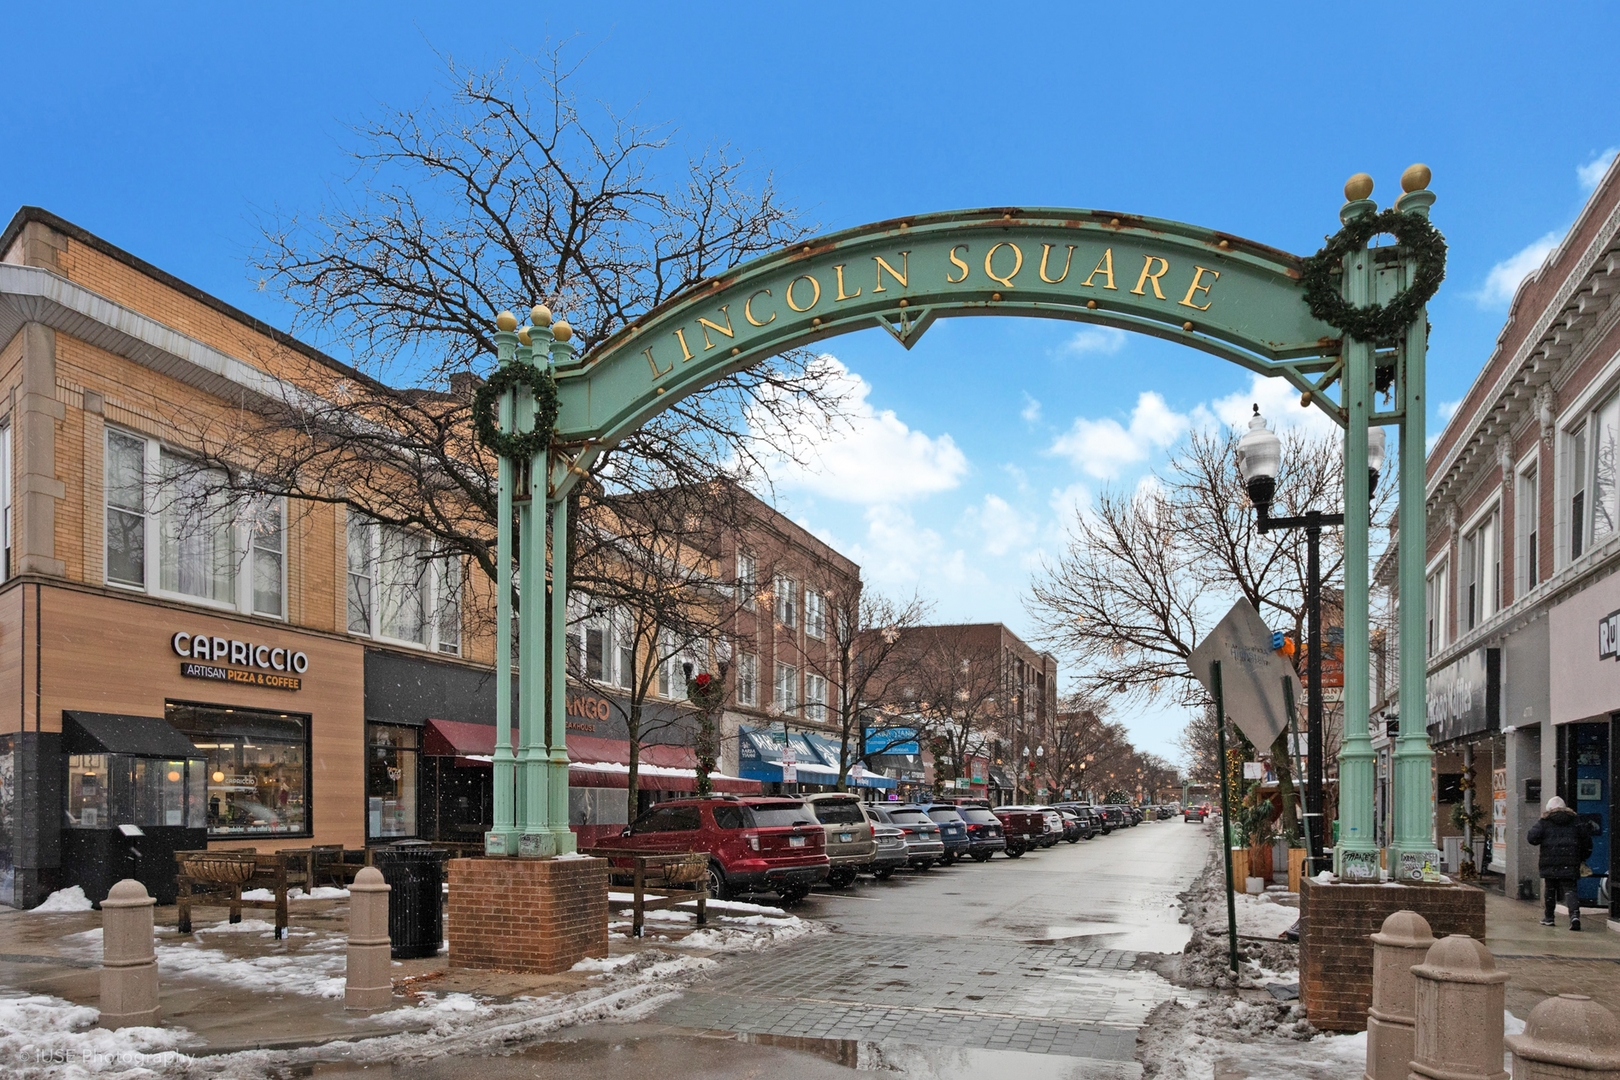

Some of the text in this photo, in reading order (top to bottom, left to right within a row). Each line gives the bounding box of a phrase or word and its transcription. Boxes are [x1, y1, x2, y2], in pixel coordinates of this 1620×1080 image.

[641, 242, 1221, 382] LINCOLN SQUARE
[171, 631, 309, 674] CAPRICCIO
[1599, 615, 1620, 657] RU
[187, 664, 299, 689] ARTISAN PIZZA & COFFEE
[565, 694, 611, 721] ANGO
